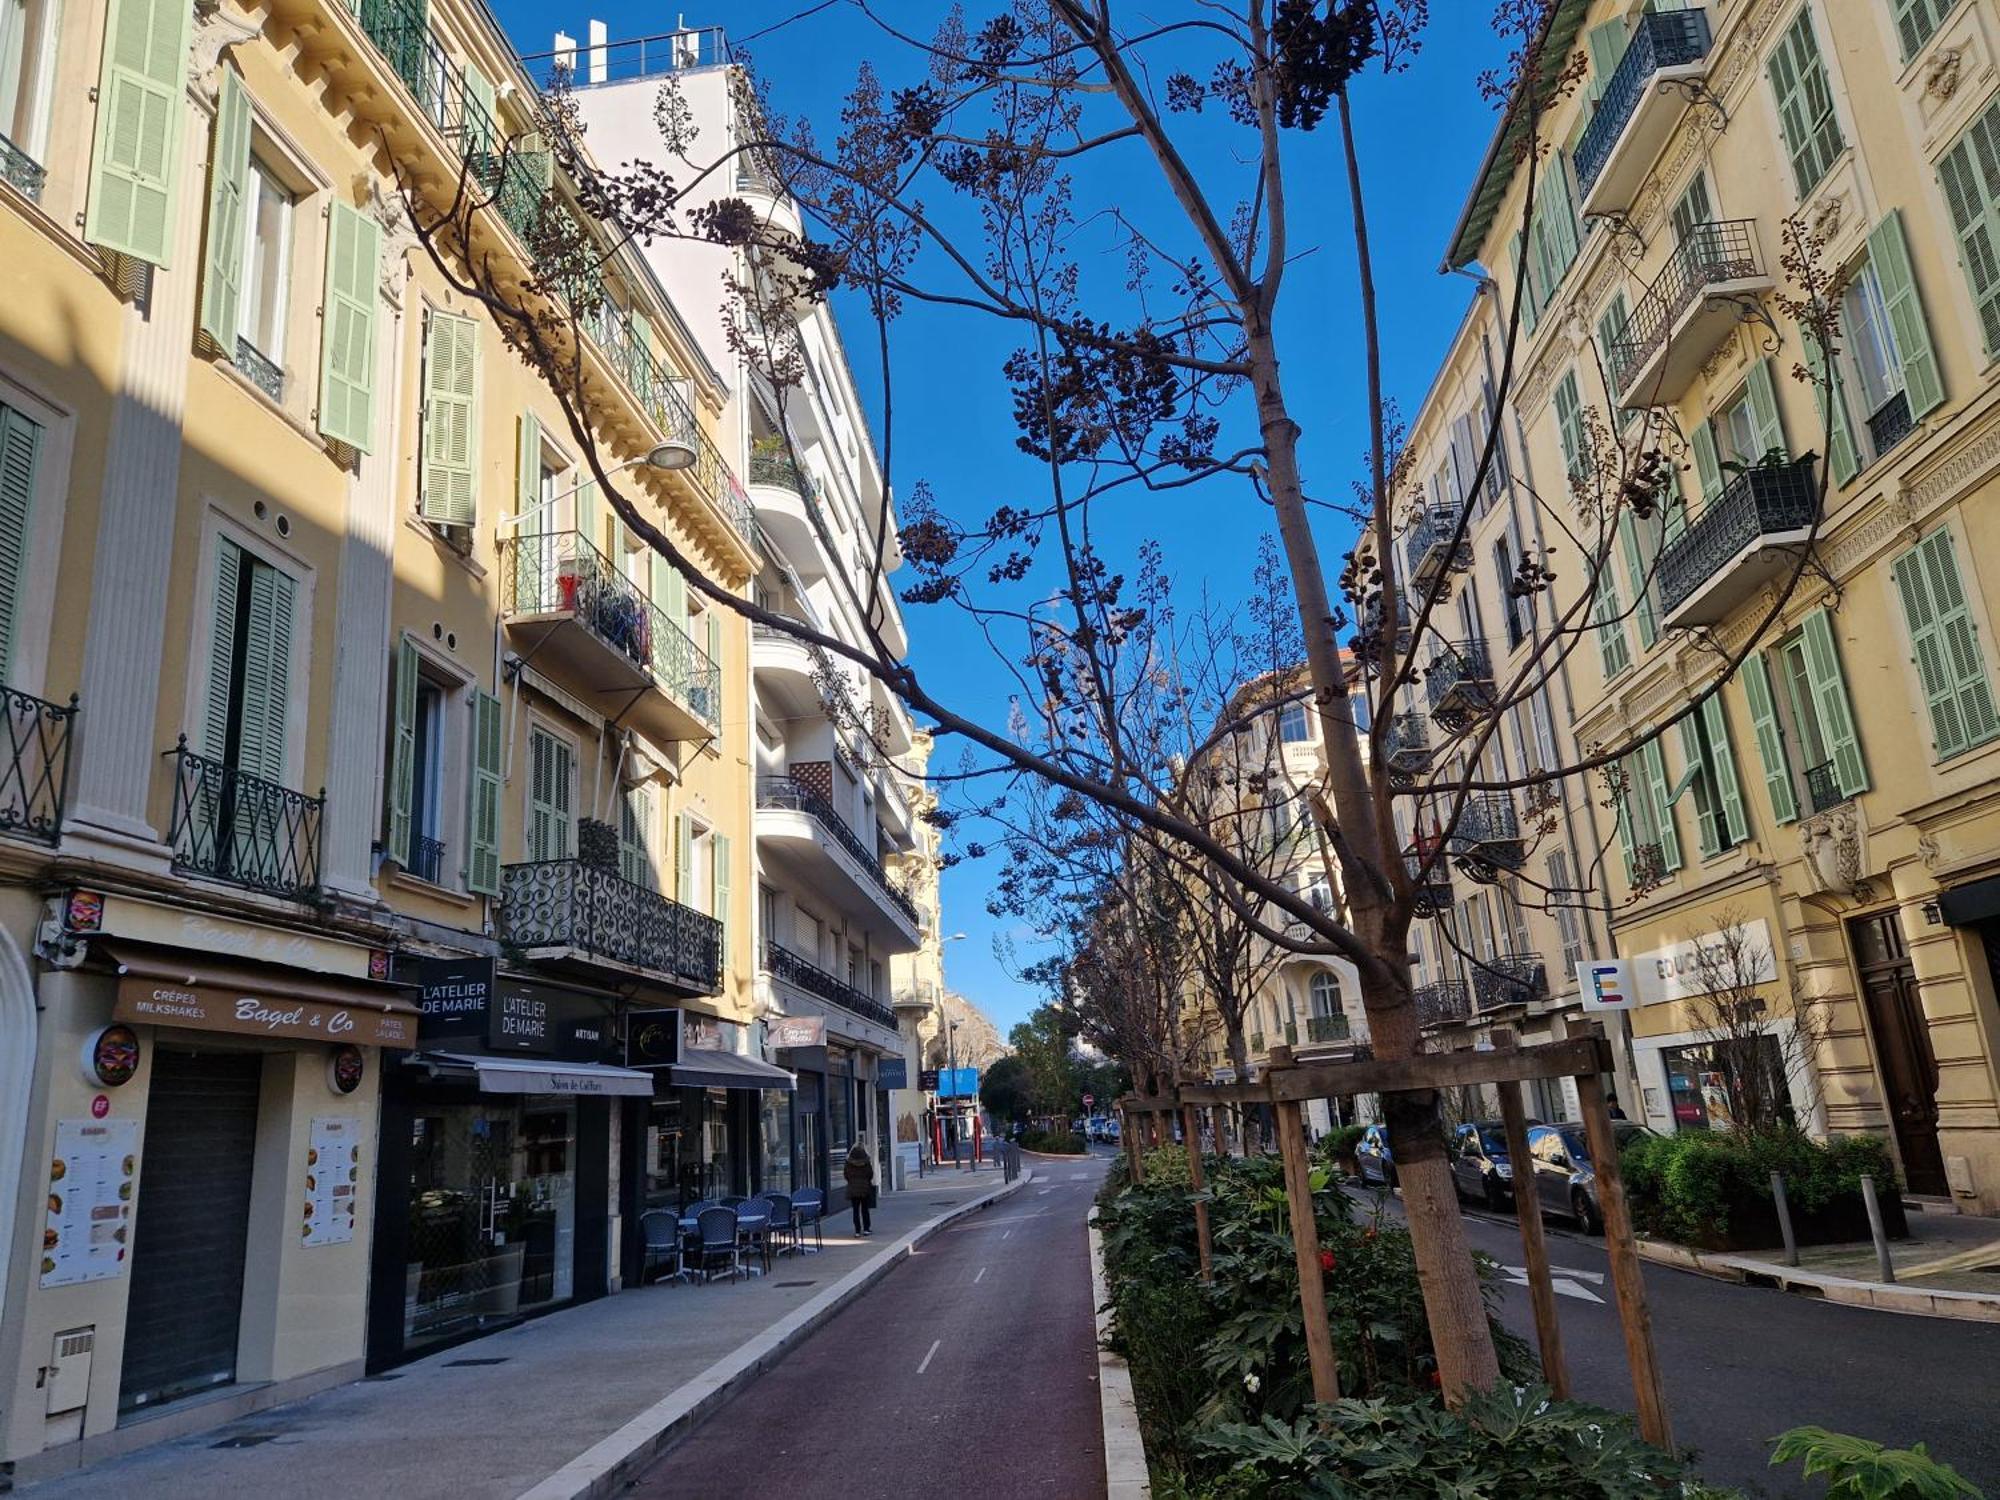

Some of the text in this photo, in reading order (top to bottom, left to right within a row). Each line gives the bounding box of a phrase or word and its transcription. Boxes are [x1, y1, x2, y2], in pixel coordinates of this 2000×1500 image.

[422, 983, 486, 1000] L'ATELIER
[135, 1001, 206, 1019] MILKSHAKES
[422, 997, 486, 1014] DE MARIE
[502, 996, 547, 1019] L'ATELIER
[235, 998, 355, 1034] Bagel & Co
[502, 1016, 546, 1038] DE MARIE
